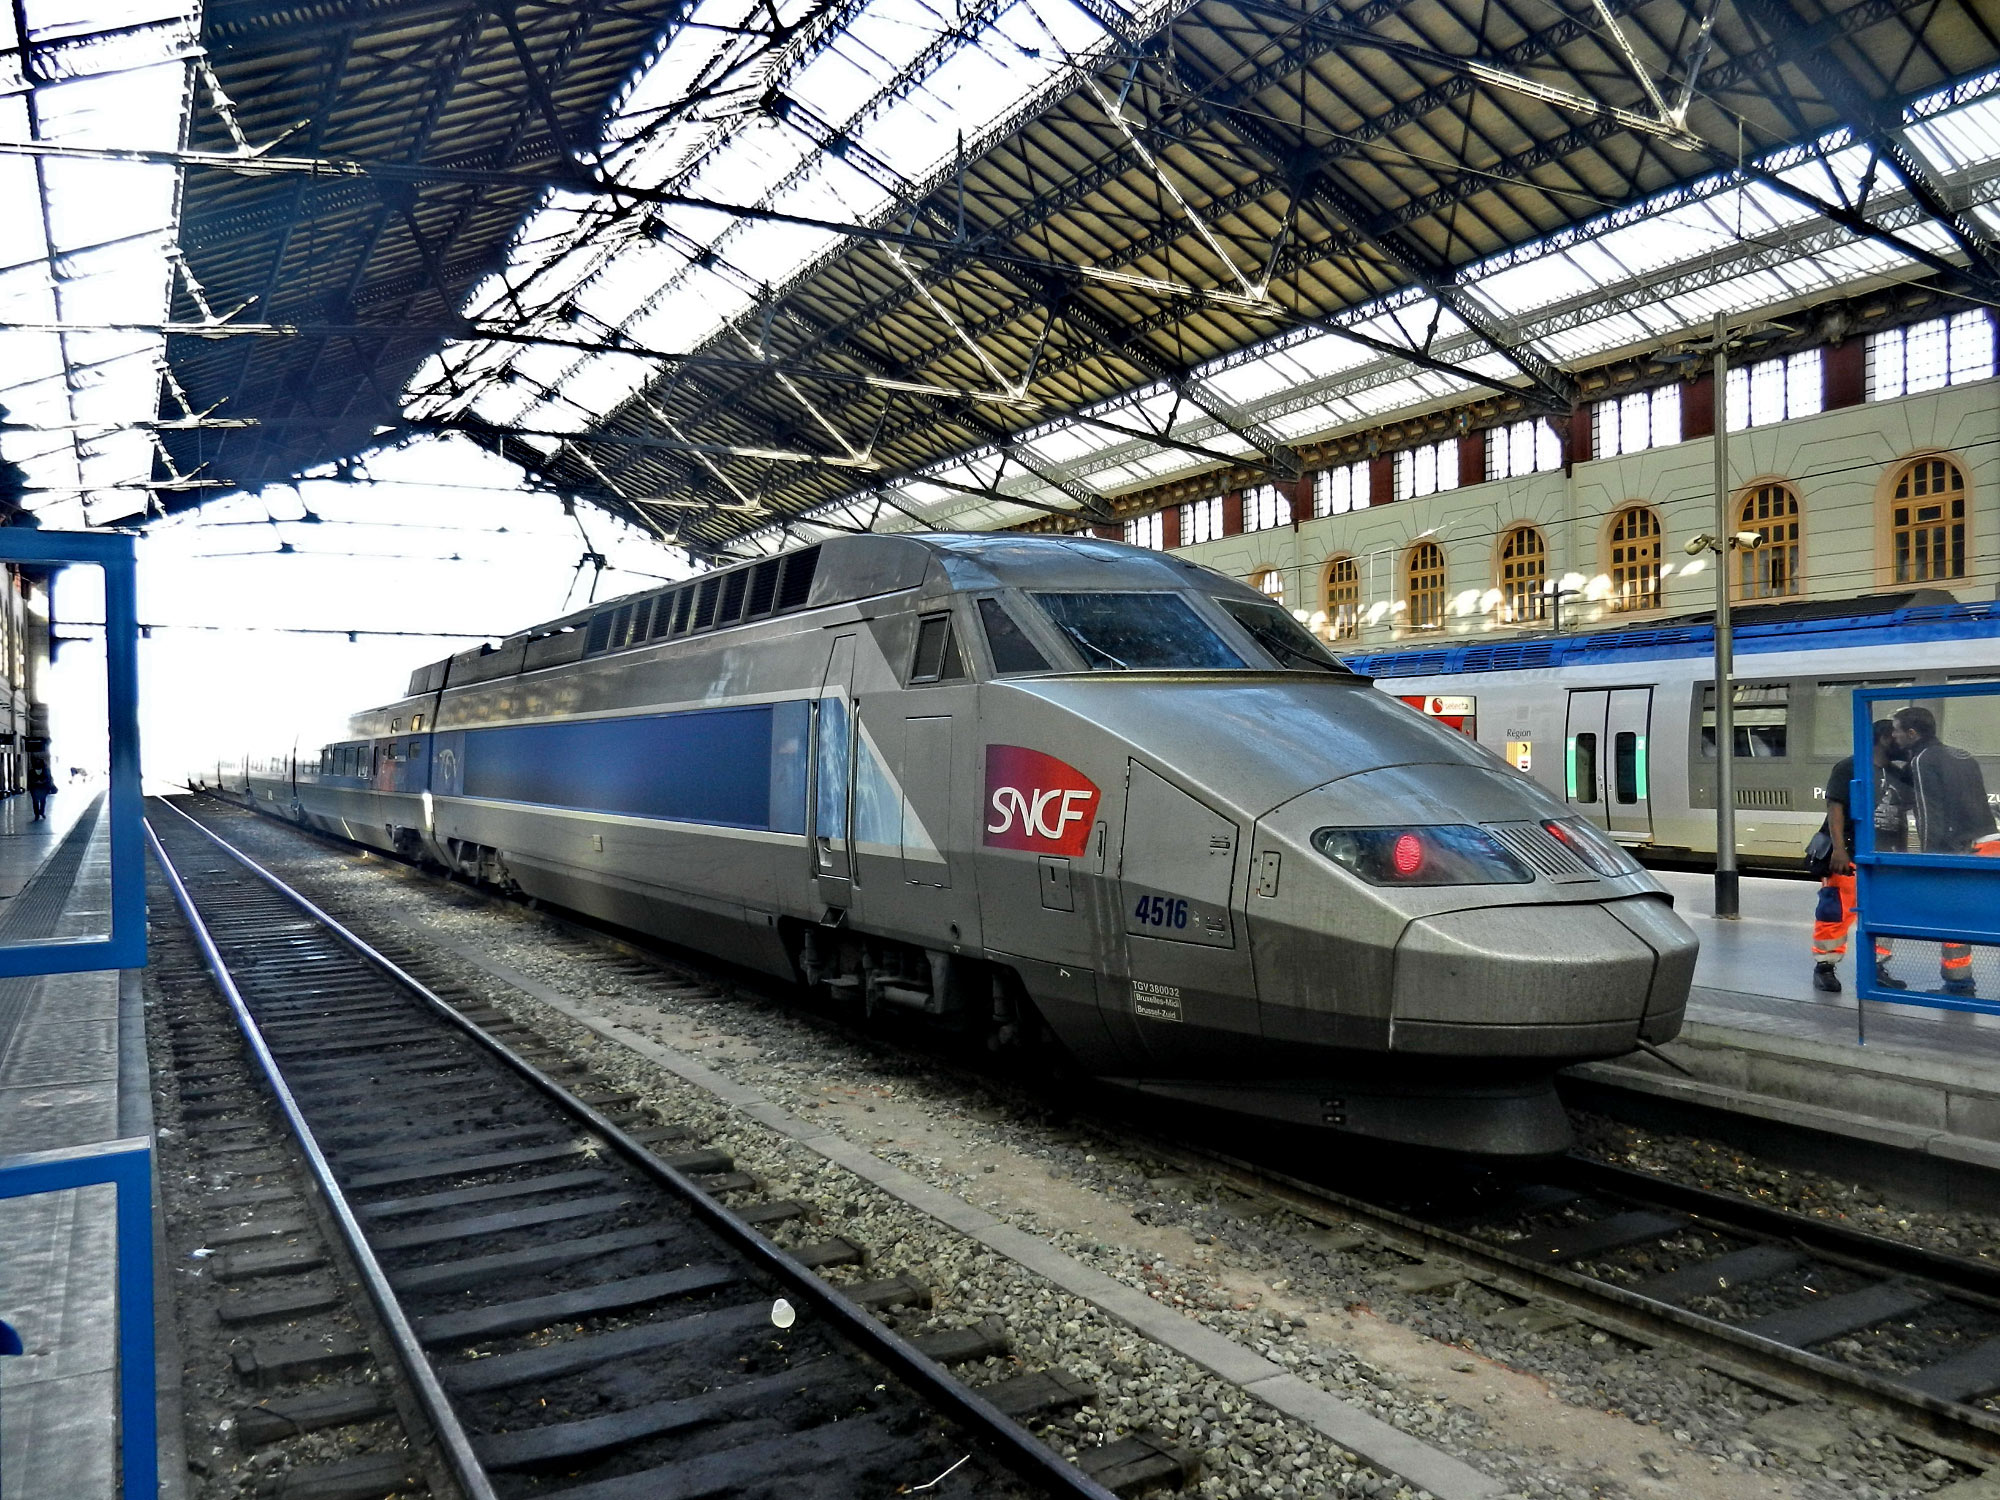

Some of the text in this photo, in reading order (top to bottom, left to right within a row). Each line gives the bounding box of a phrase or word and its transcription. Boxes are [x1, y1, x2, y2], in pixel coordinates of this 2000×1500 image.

[1506, 728, 1532, 739] Région
[1637, 739, 1645, 750] 2
[987, 786, 1093, 839] SNCF
[1135, 895, 1188, 929] 4516
